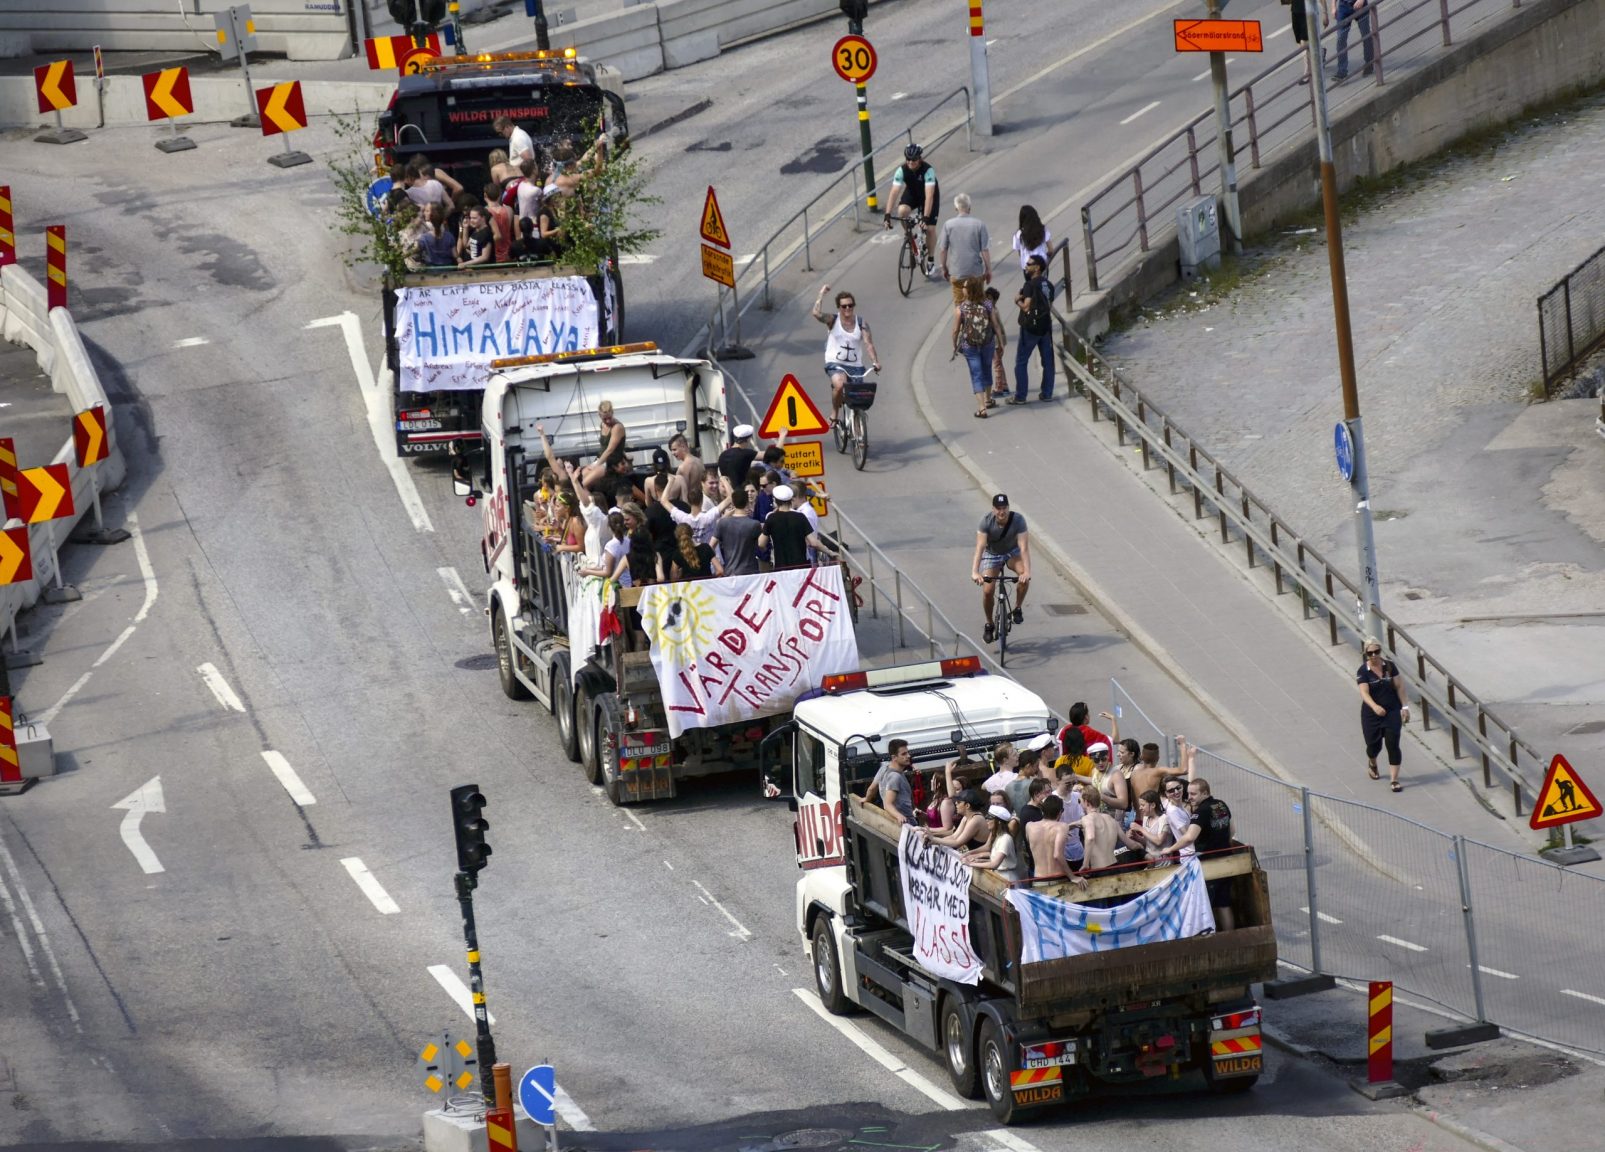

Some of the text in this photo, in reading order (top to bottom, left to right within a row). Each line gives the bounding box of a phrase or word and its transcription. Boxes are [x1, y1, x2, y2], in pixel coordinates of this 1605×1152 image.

[840, 47, 870, 71] 30
[448, 106, 550, 123] WILDA TRANSPORT
[479, 284, 504, 295] DEN
[784, 460, 820, 471] ggtrafik
[718, 567, 841, 711] TRANSPORT
[905, 830, 970, 896] KLASSEN SOM
[943, 891, 967, 920] MED
[1030, 1053, 1071, 1068] CHD 144
[1215, 1056, 1261, 1074] WILDA
[1015, 1086, 1062, 1104] WILDA
